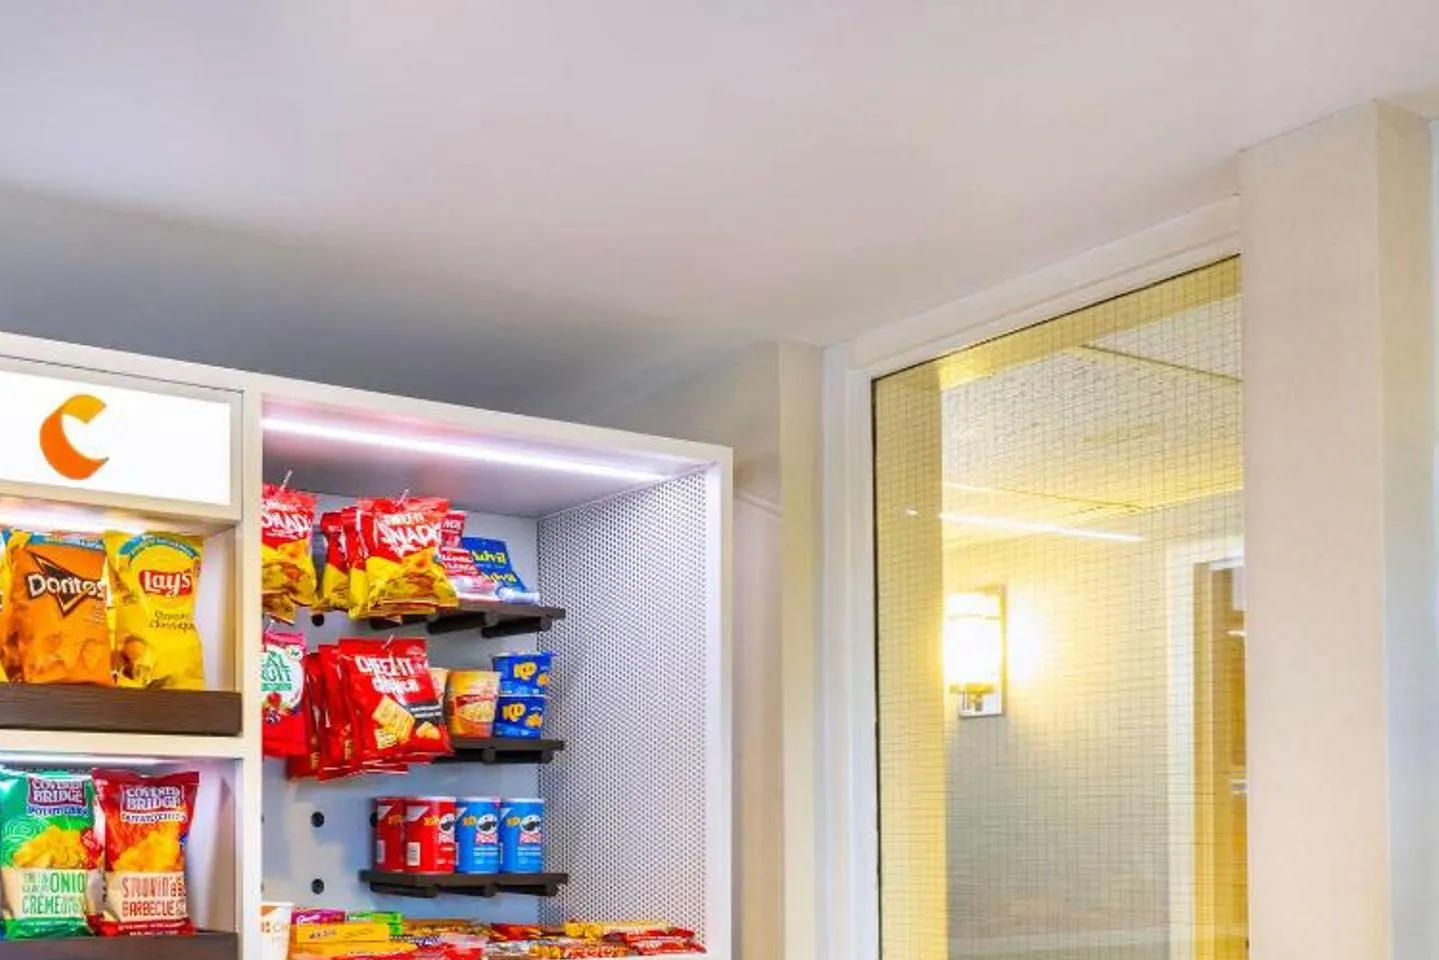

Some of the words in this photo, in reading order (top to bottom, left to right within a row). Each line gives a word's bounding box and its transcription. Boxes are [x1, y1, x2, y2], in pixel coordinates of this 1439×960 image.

[27, 573, 106, 599] Doritos
[144, 571, 193, 597] Lay's
[33, 789, 83, 803] BRIDGE
[50, 872, 86, 893] ONIO
